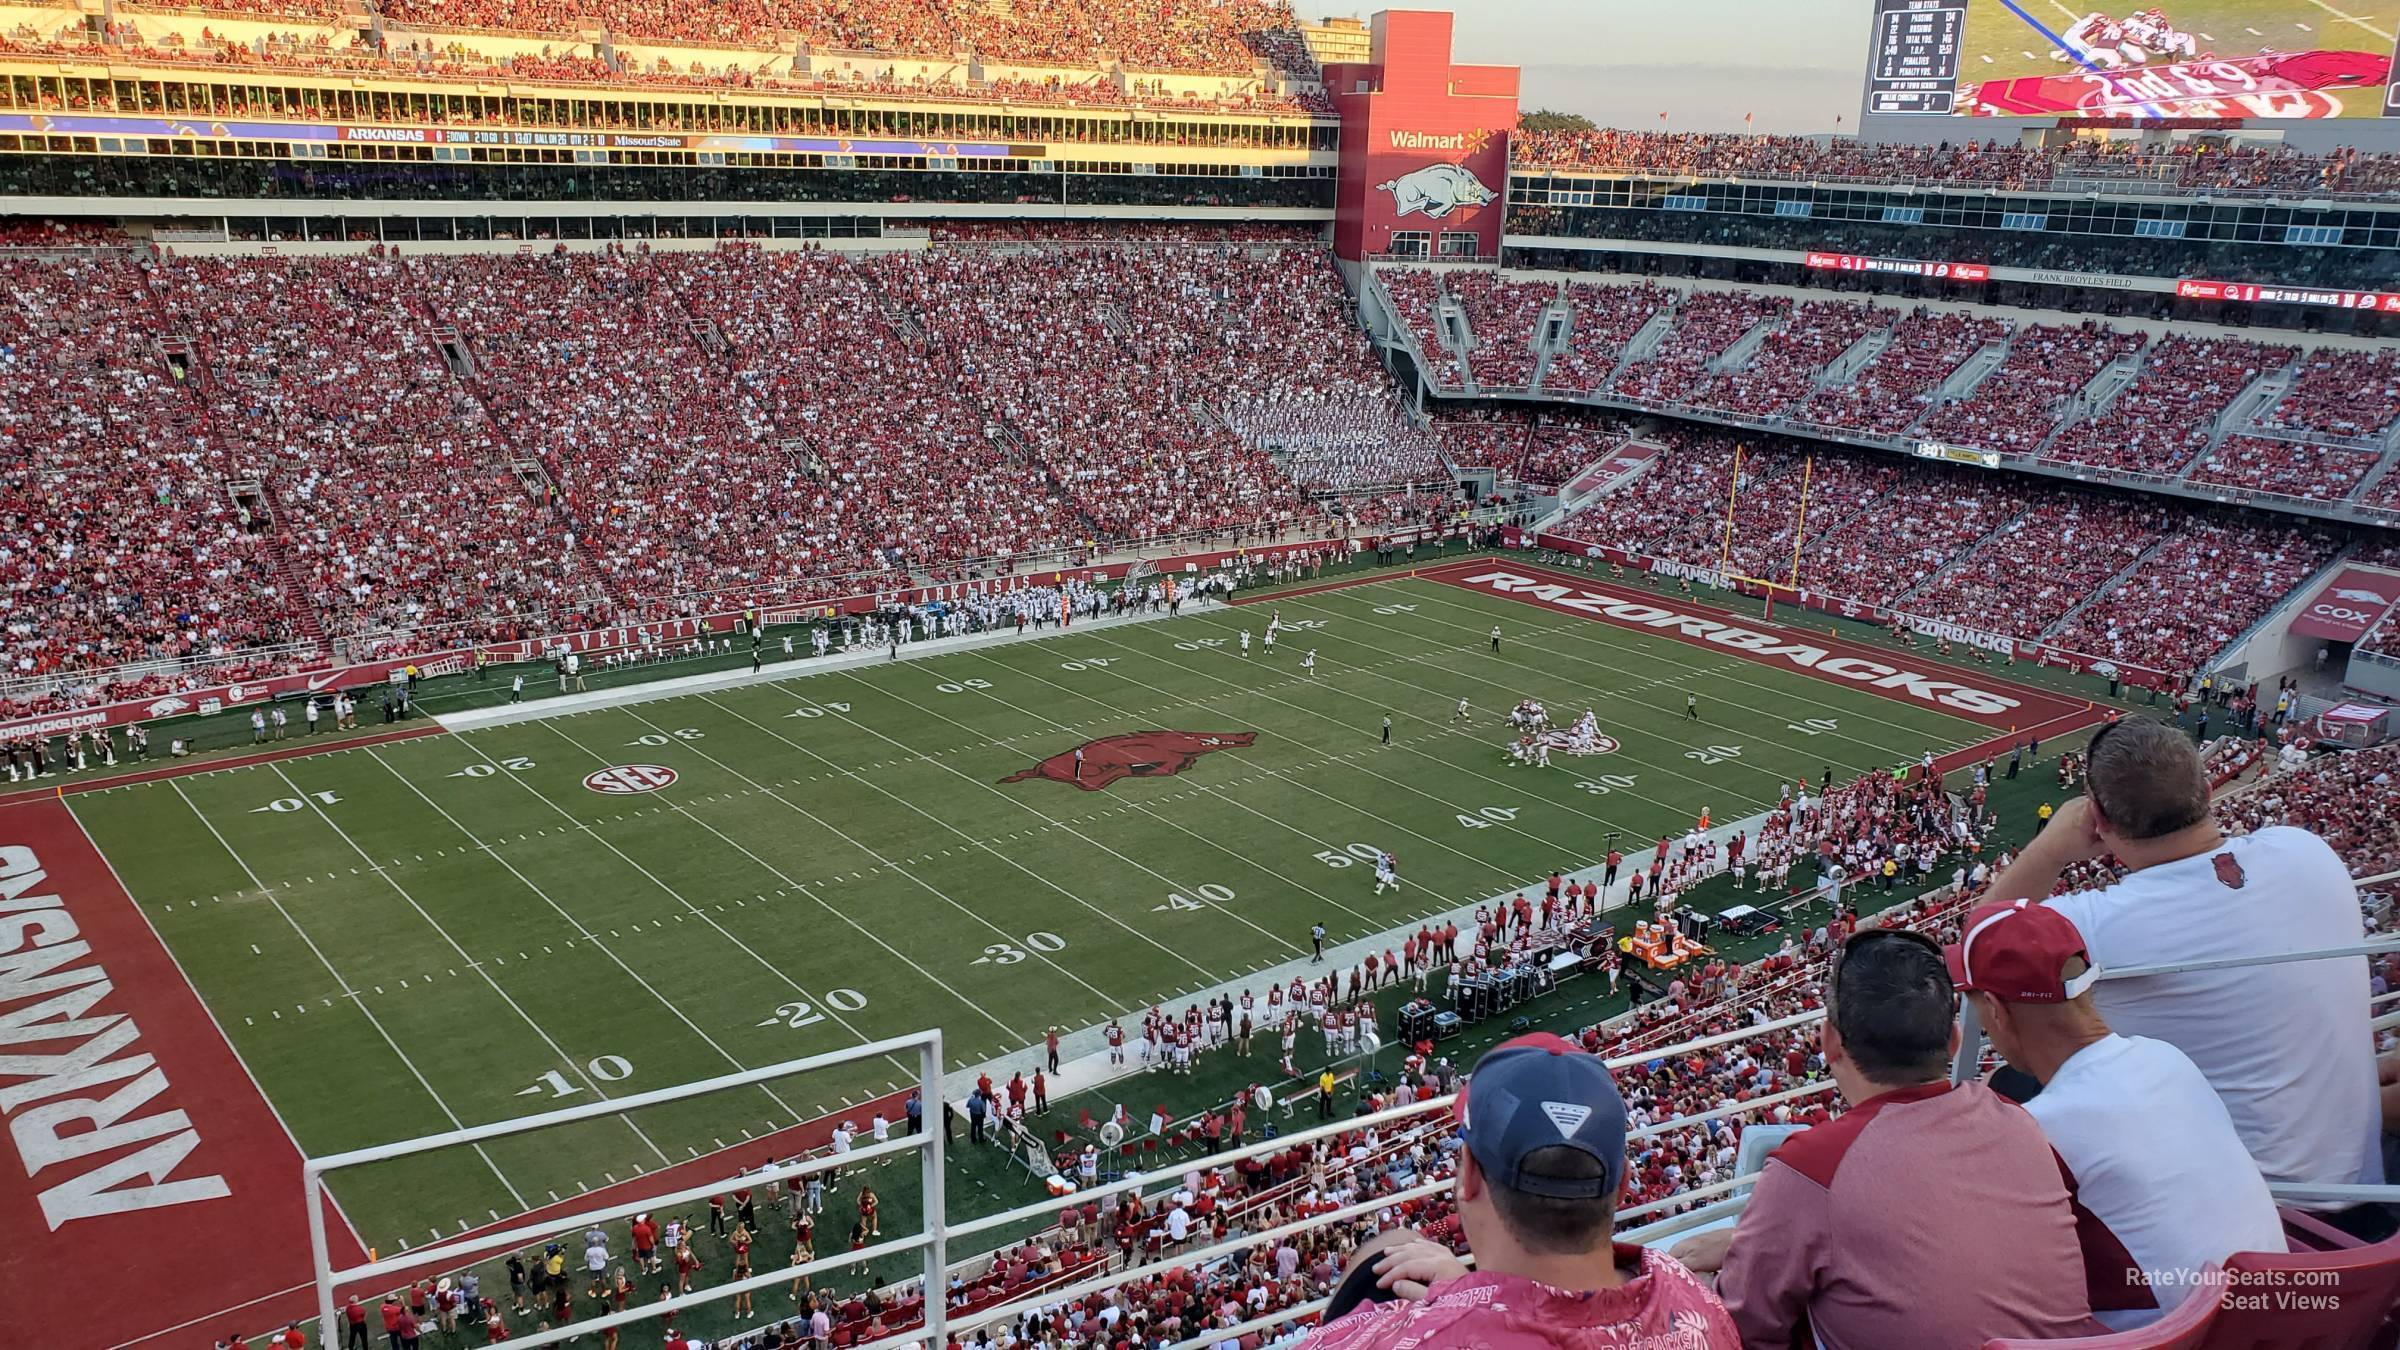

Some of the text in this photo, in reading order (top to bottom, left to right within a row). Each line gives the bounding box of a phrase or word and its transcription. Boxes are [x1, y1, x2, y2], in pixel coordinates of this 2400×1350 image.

[2083, 69, 2183, 104] 2nd
[2210, 62, 2257, 91] 9
[348, 128, 424, 141] ARKANSAS
[474, 132, 480, 143] 2
[1390, 130, 1464, 149] Walmart
[2033, 272, 2132, 288] FRANK BROYLES FIELD
[1651, 559, 1729, 590] ARKANSAS
[921, 575, 1030, 603] ARKANSAS
[2314, 604, 2372, 624] COX
[1174, 638, 1220, 651] 30
[1461, 570, 2022, 715] RAZORBACKS
[1062, 658, 1110, 672] 40
[936, 678, 992, 693] 50
[797, 701, 853, 719] 40
[638, 727, 706, 747] 30
[1788, 717, 1836, 736] 10
[1684, 745, 1743, 765] 20
[464, 755, 537, 778] 20
[588, 767, 675, 793] SEC
[1574, 774, 1635, 795] 30
[268, 789, 344, 813] 10
[1455, 804, 1516, 830] 40
[1313, 842, 1386, 868] 50
[1167, 882, 1237, 912] 40
[985, 932, 1067, 965] 30
[776, 988, 869, 1029] 20
[536, 1054, 634, 1099] 10
